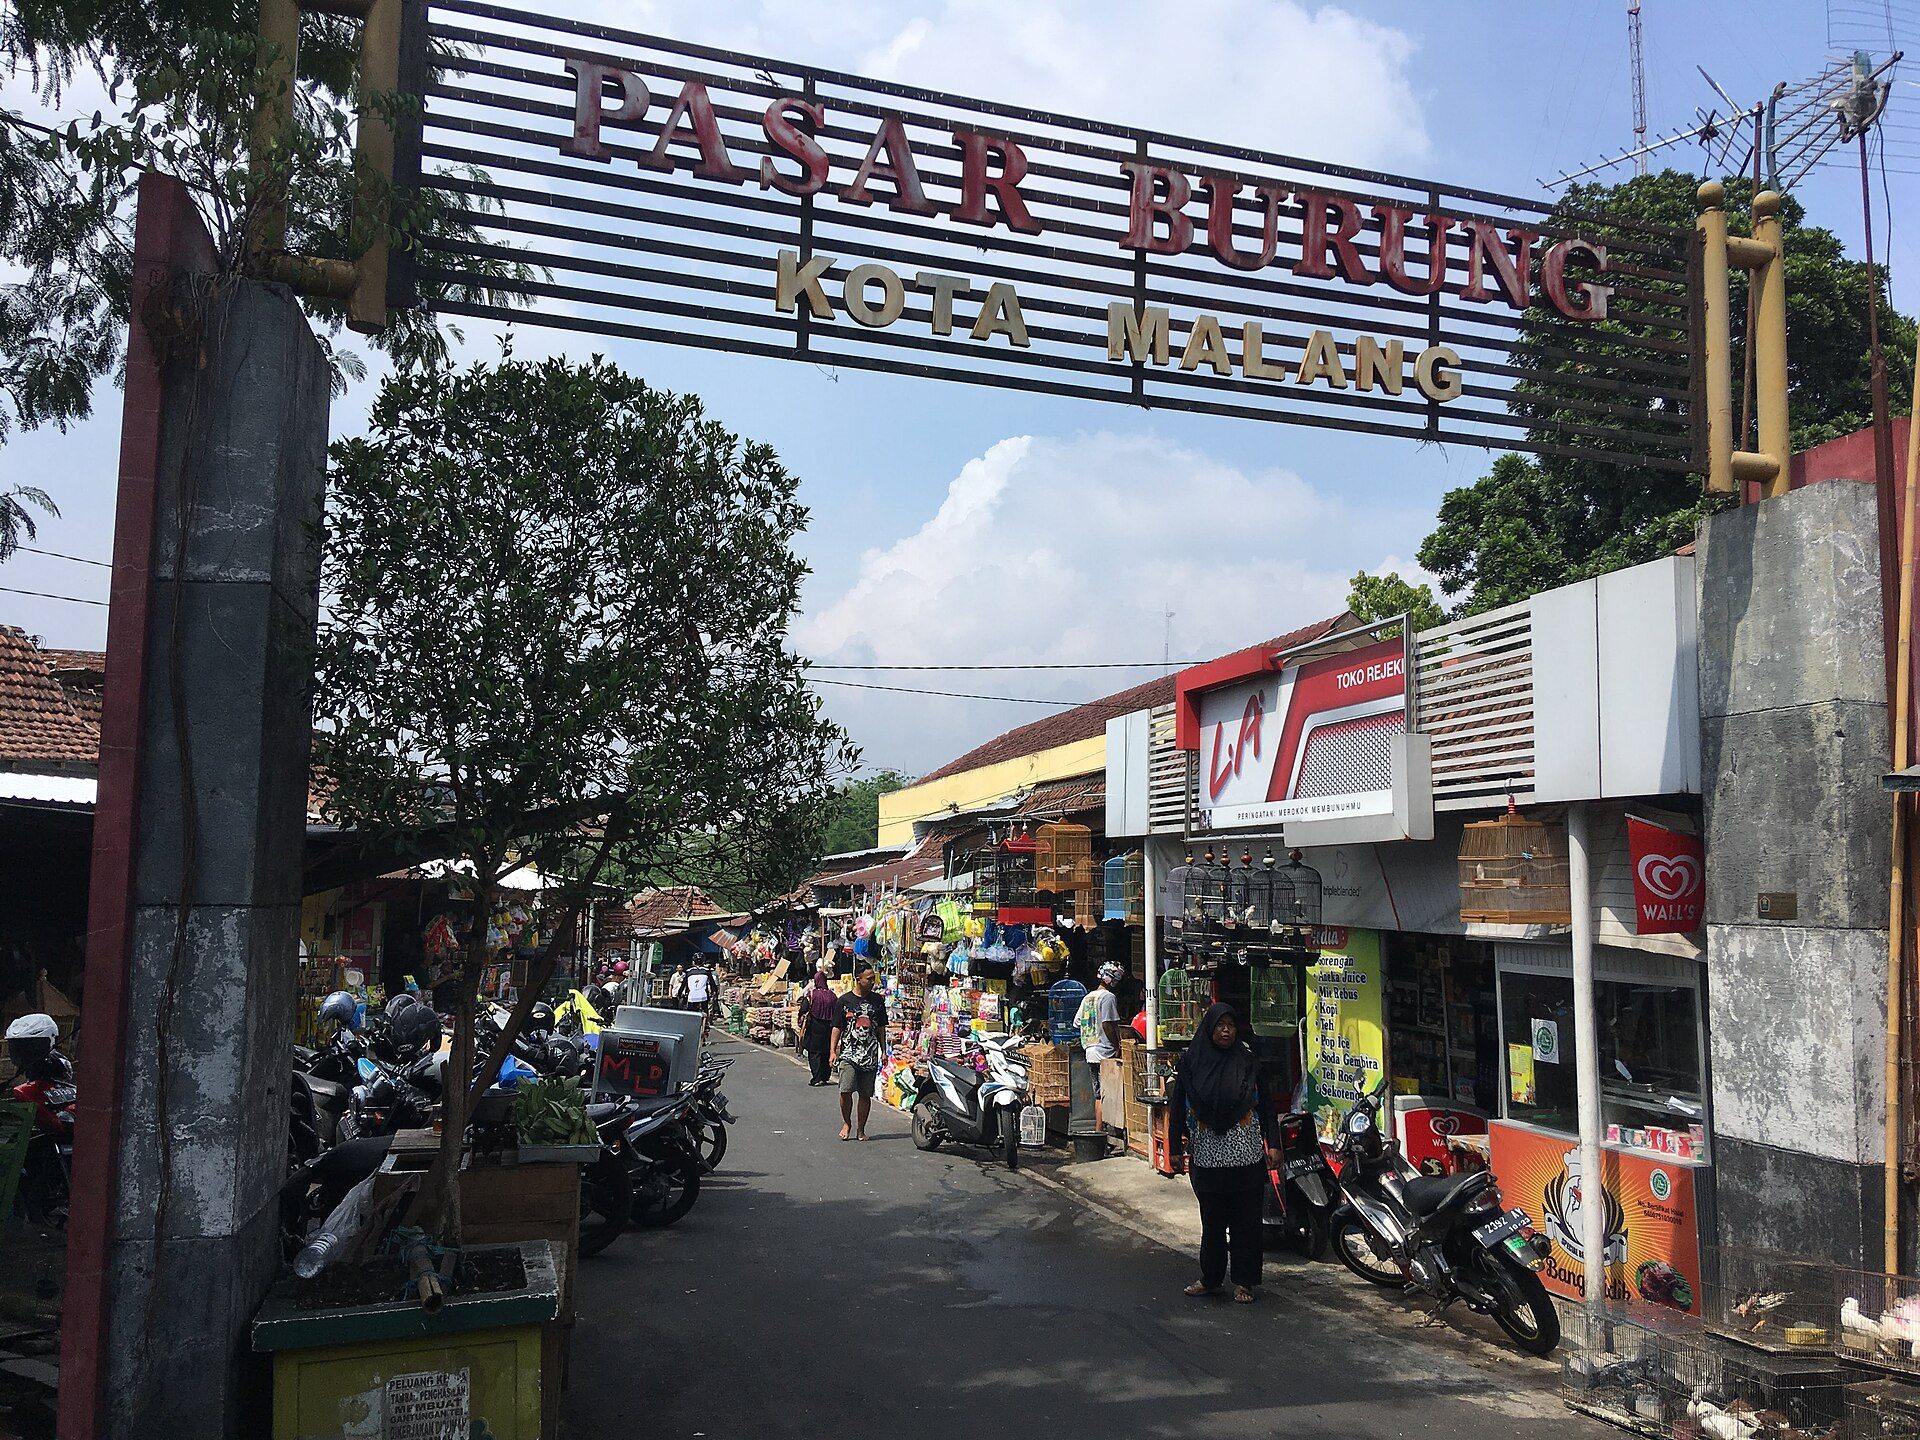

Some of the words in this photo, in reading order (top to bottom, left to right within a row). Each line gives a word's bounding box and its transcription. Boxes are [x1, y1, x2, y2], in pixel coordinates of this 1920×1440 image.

[559, 58, 1042, 236] PASAR
[1119, 162, 1615, 321] BURUNG
[775, 249, 1031, 348] KOTA
[1107, 302, 1462, 402] MALANG
[1336, 670, 1365, 690] TOKO
[1366, 658, 1405, 683] REJEKI
[1237, 810, 1276, 820] PERINGATAN:
[1278, 806, 1309, 817] MEROKOK
[1311, 802, 1361, 813] MEMBUNUHMU
[1642, 904, 1696, 921] WALL'S
[1318, 972, 1340, 983] Aneka
[1341, 971, 1367, 984] Juice
[1333, 987, 1358, 1001] Rebus
[1319, 1003, 1338, 1017] Kopi
[1320, 1019, 1334, 1031] Teh
[1321, 1035, 1335, 1050] Pop
[1337, 1036, 1350, 1049] Ice
[1321, 1051, 1341, 1065] Soda
[1343, 1053, 1379, 1070] Gembira
[1322, 1068, 1336, 1082] Teh
[1338, 1070, 1353, 1083] Ros
[1484, 1216, 1508, 1234] 2392
[1546, 1256, 1585, 1298] Bang
[389, 1376, 434, 1390] PELUANG
[394, 1397, 462, 1415] MEMBUAT
